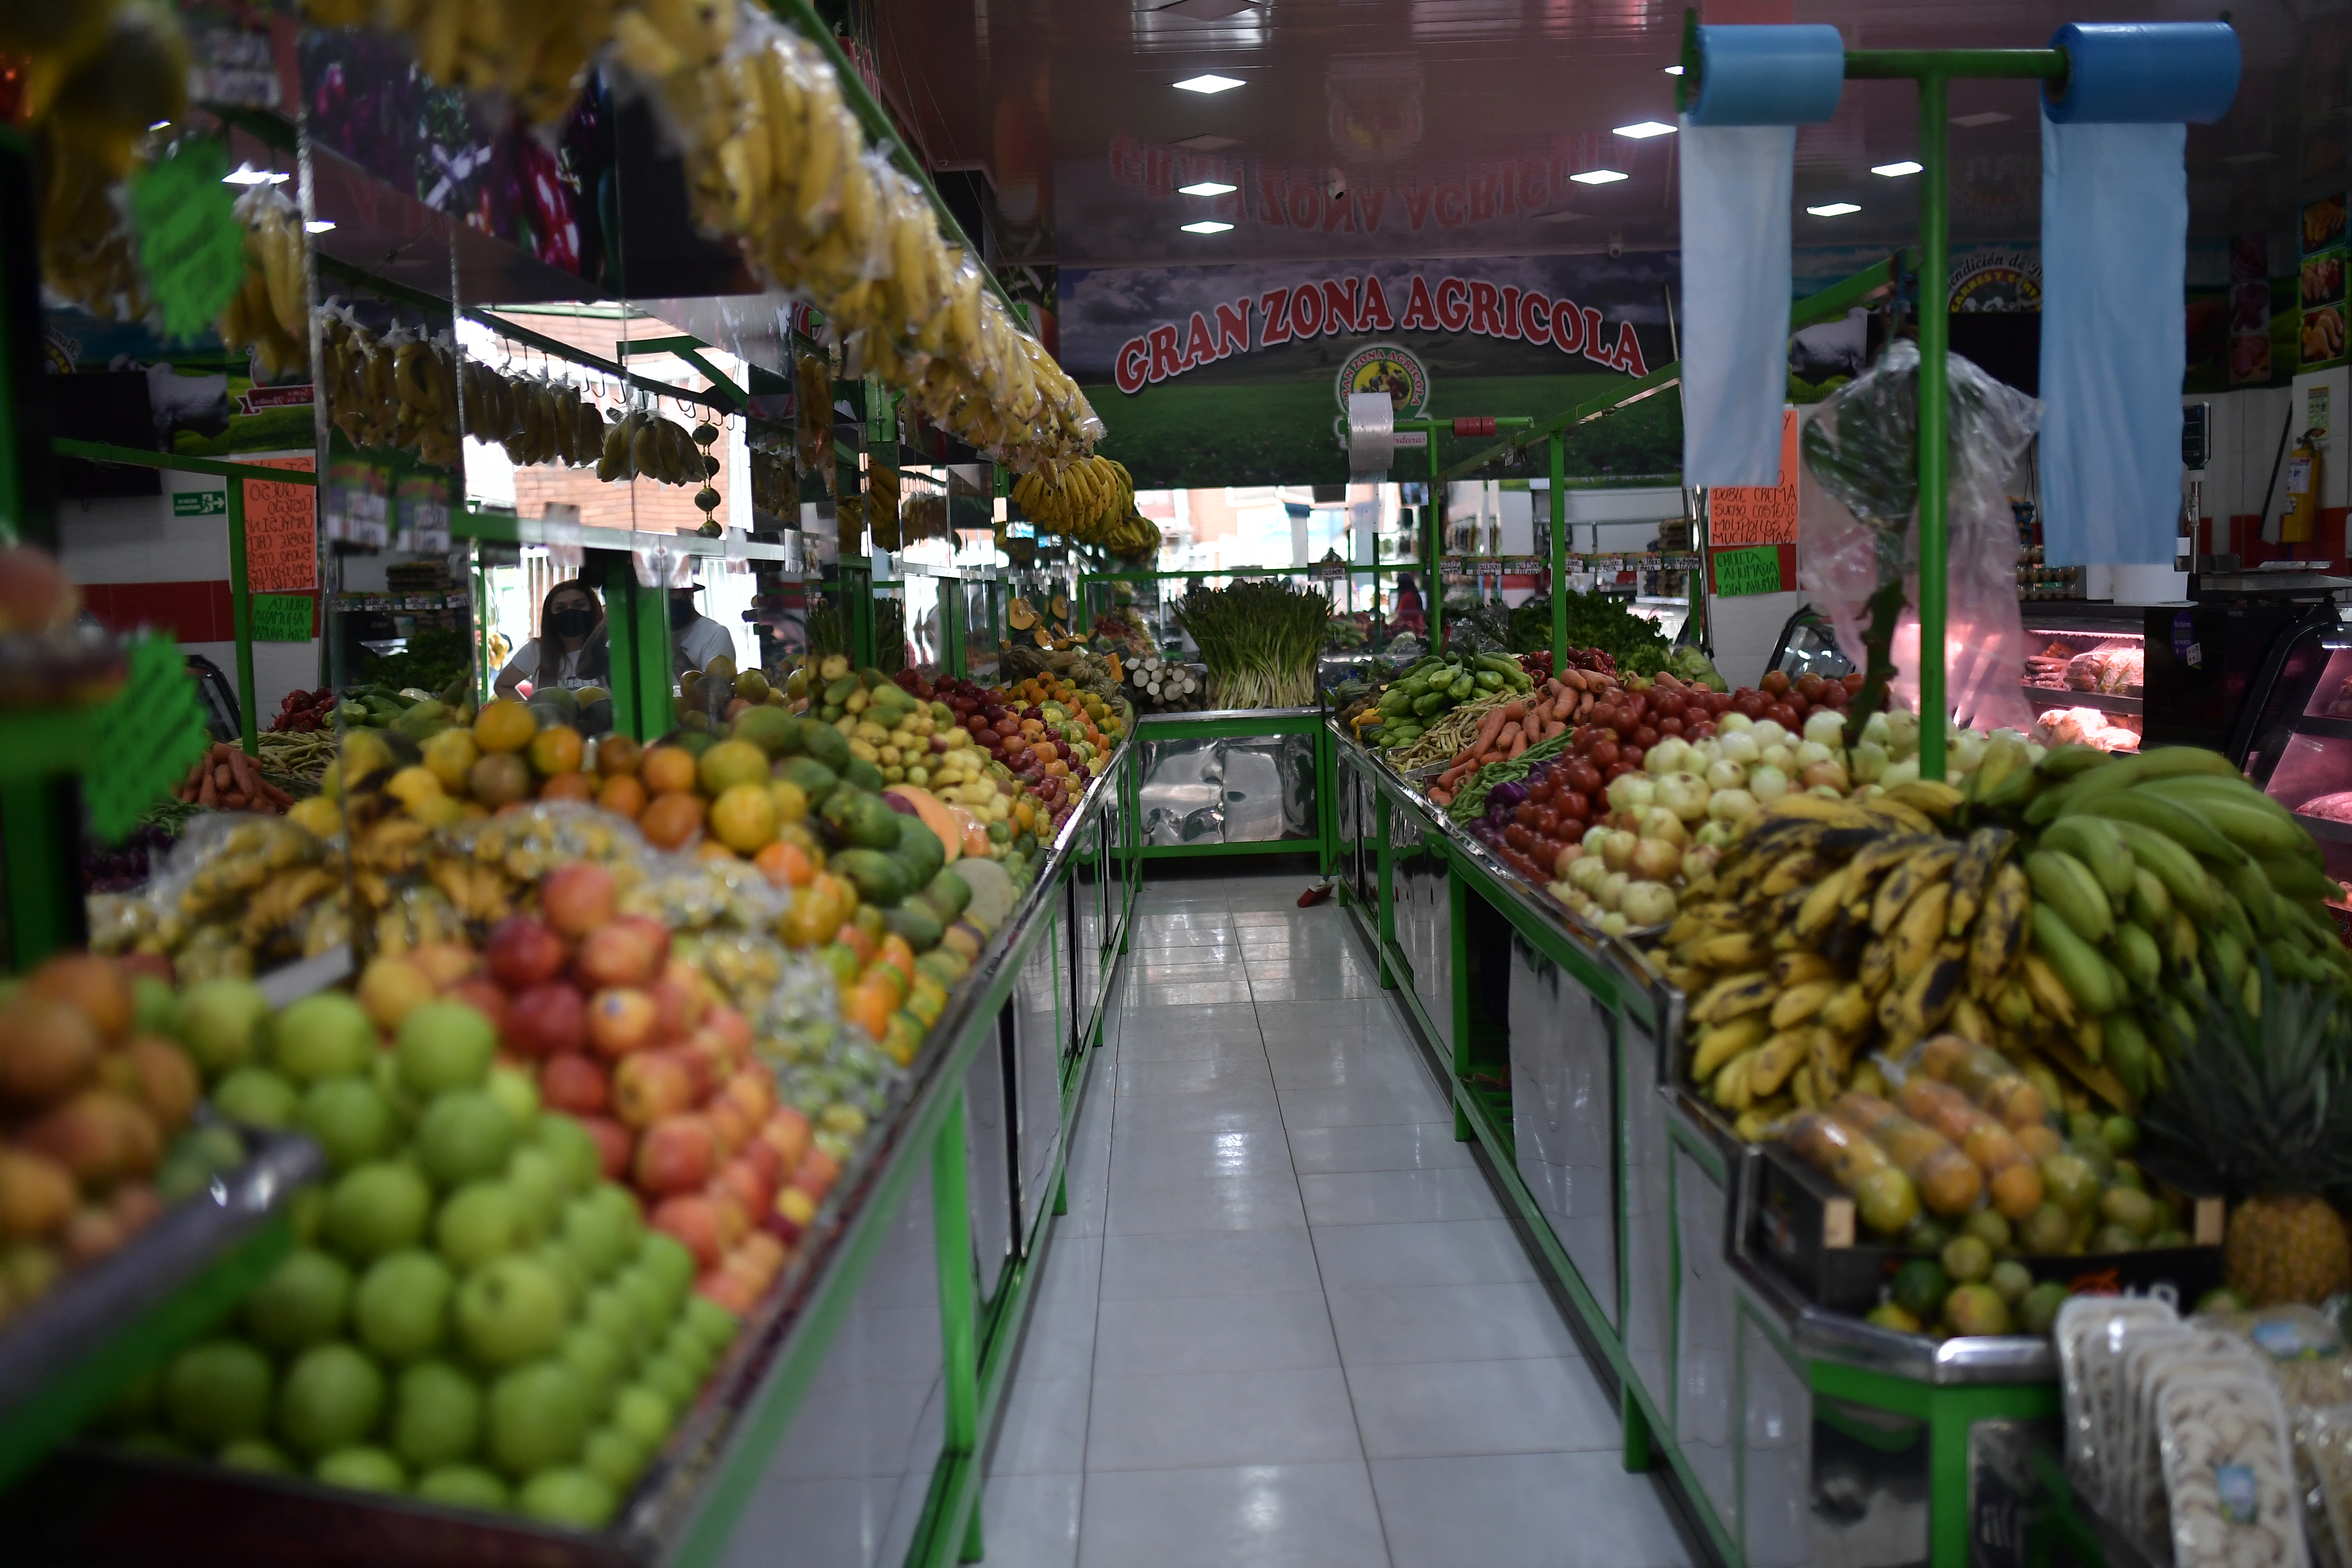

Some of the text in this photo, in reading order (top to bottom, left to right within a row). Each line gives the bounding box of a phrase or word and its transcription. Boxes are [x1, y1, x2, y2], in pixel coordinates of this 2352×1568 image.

[1948, 251, 2004, 287] endición
[1114, 276, 1648, 395] GRAN ZONA AGRICOLA
[1351, 349, 1386, 370] ZONA
[1388, 351, 1424, 406] AGRICOLA
[1713, 484, 1797, 503] DOBLE CREMA
[1715, 504, 1746, 517] SUERO
[1785, 517, 1795, 533] Y
[1712, 529, 1793, 545] MUCHO MAS
[1716, 551, 1762, 567] CHULETA
[1724, 561, 1778, 581] AHUMADA
[1717, 584, 1722, 597] Y
[1724, 582, 1741, 597] SIN
